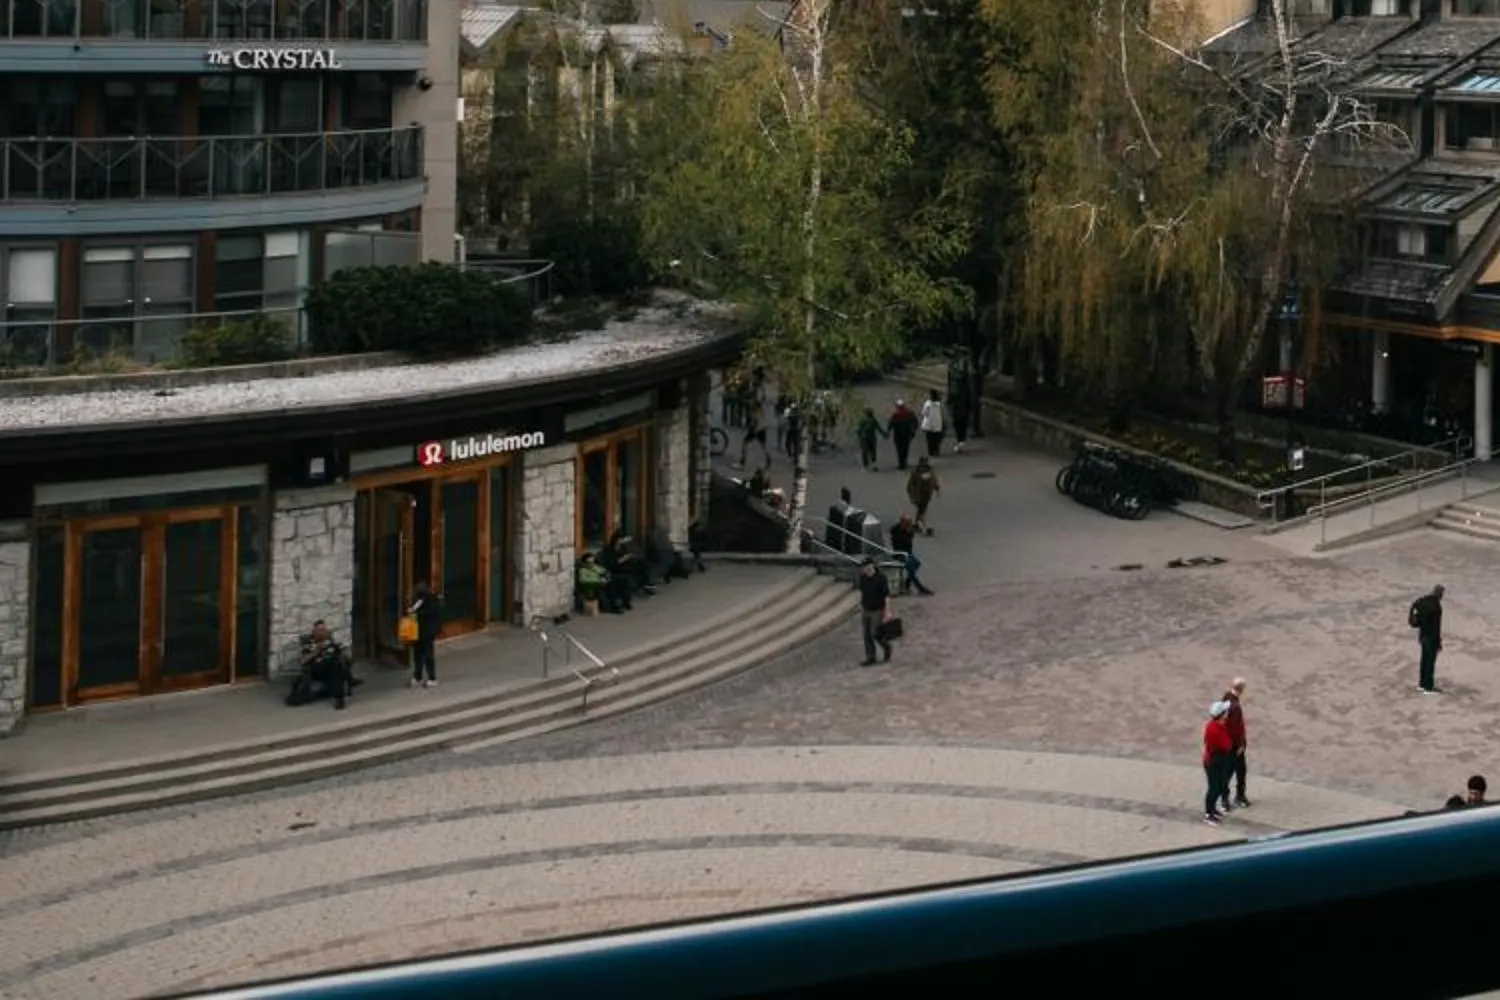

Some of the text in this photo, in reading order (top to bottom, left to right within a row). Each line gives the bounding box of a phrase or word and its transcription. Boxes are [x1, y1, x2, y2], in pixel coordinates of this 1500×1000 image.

[207, 48, 343, 69] The CRYSTAL
[451, 431, 545, 461] lululemon
